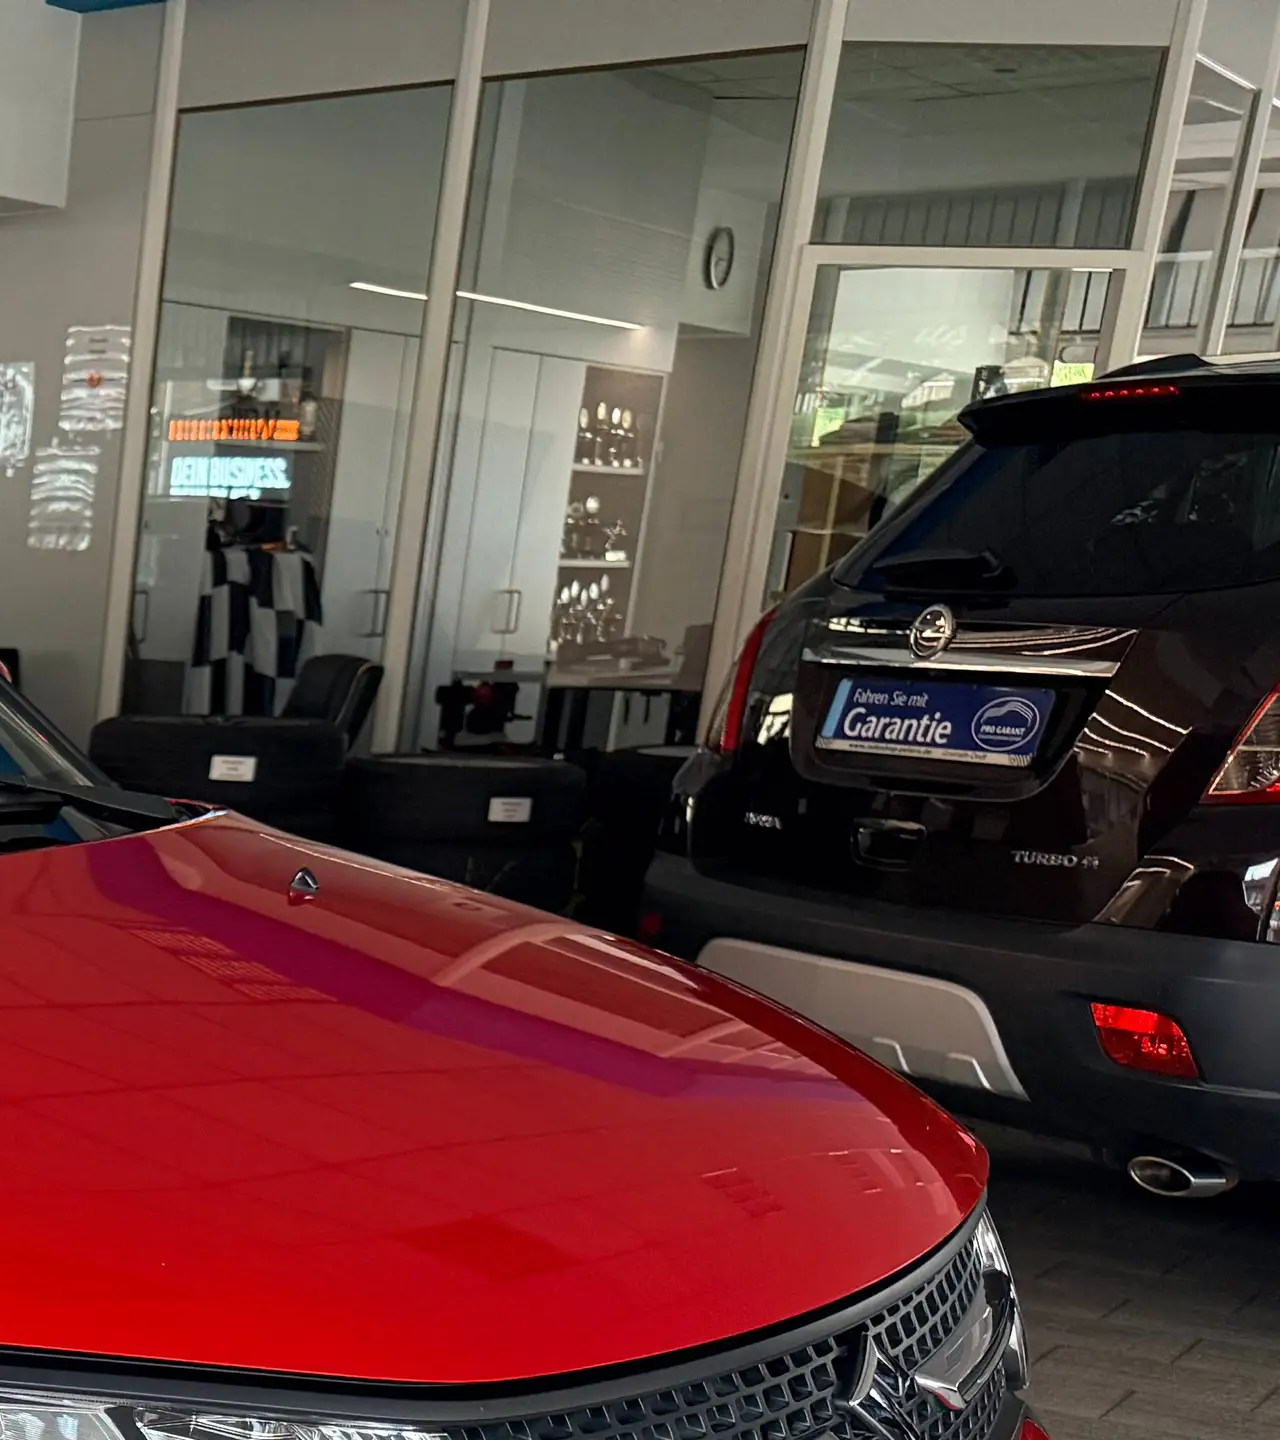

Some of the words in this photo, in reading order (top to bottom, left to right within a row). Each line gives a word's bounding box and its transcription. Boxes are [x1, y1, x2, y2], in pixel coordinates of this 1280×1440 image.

[853, 688, 888, 705] Fahren
[890, 691, 907, 706] Sie
[908, 692, 929, 708] mit
[844, 707, 952, 744] Garantie
[996, 726, 1026, 736] GARANT
[1010, 850, 1078, 868] TURBO
